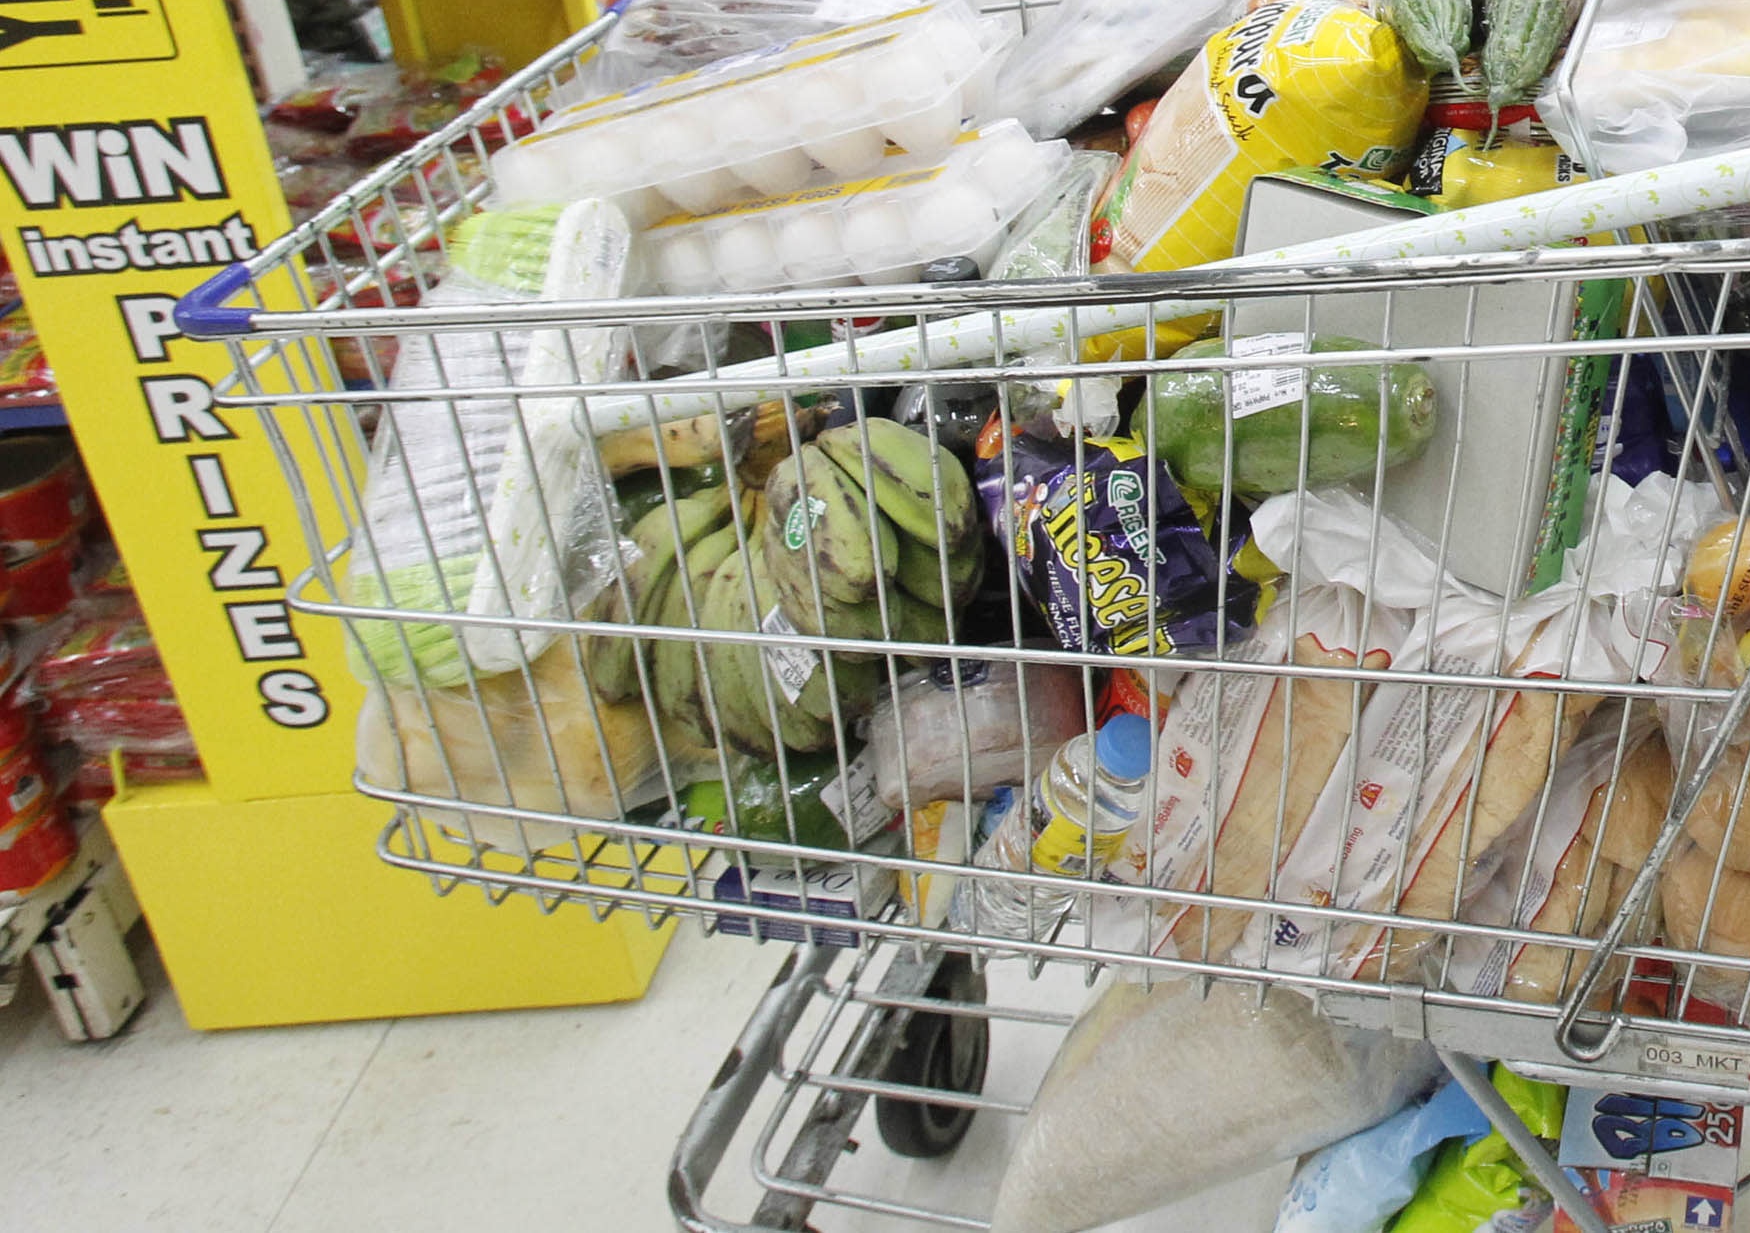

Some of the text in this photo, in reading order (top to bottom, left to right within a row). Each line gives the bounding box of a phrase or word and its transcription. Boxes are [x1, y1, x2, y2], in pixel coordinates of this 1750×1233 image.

[19, 211, 262, 277] instant
[116, 291, 330, 729] PRIZES
[1046, 560, 1075, 613] CHEESE
[1049, 601, 1074, 650] SNACK
[1645, 1047, 1683, 1064] 003
